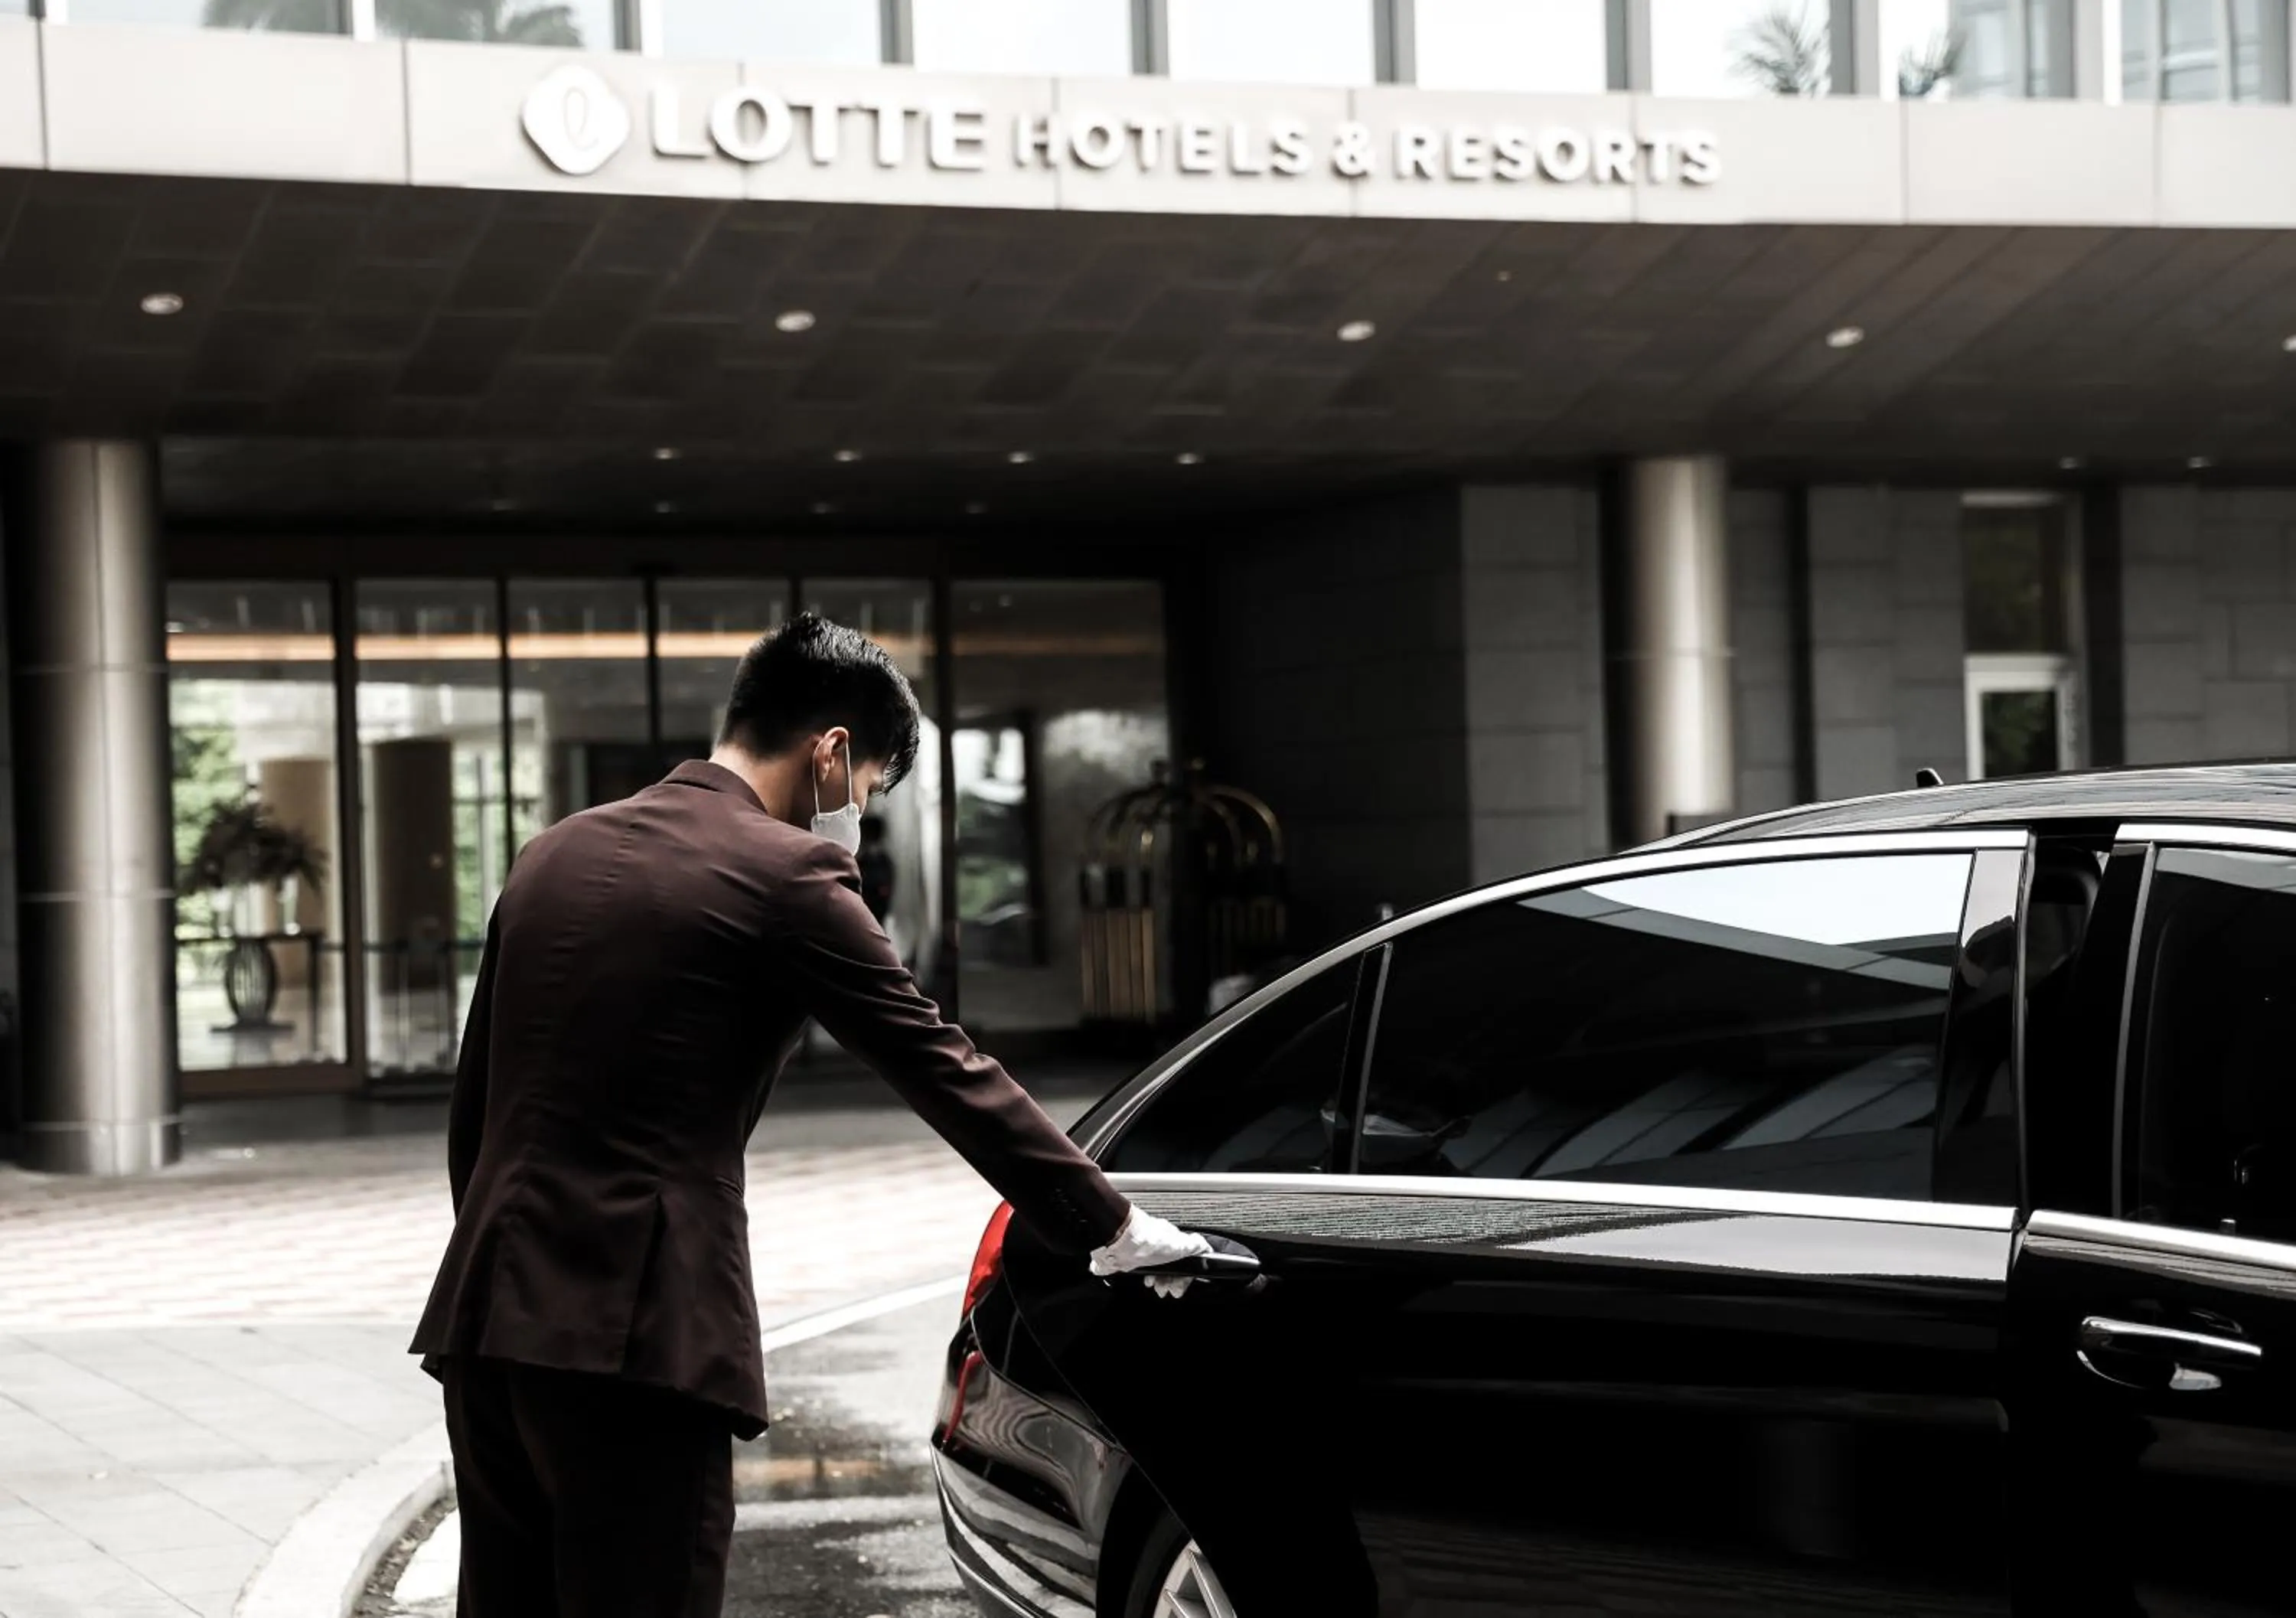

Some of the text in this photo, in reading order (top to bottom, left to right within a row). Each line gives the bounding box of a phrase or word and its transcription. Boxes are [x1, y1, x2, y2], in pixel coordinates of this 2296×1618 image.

[651, 82, 1722, 184] LOTTE HOTELS & RESORTS
